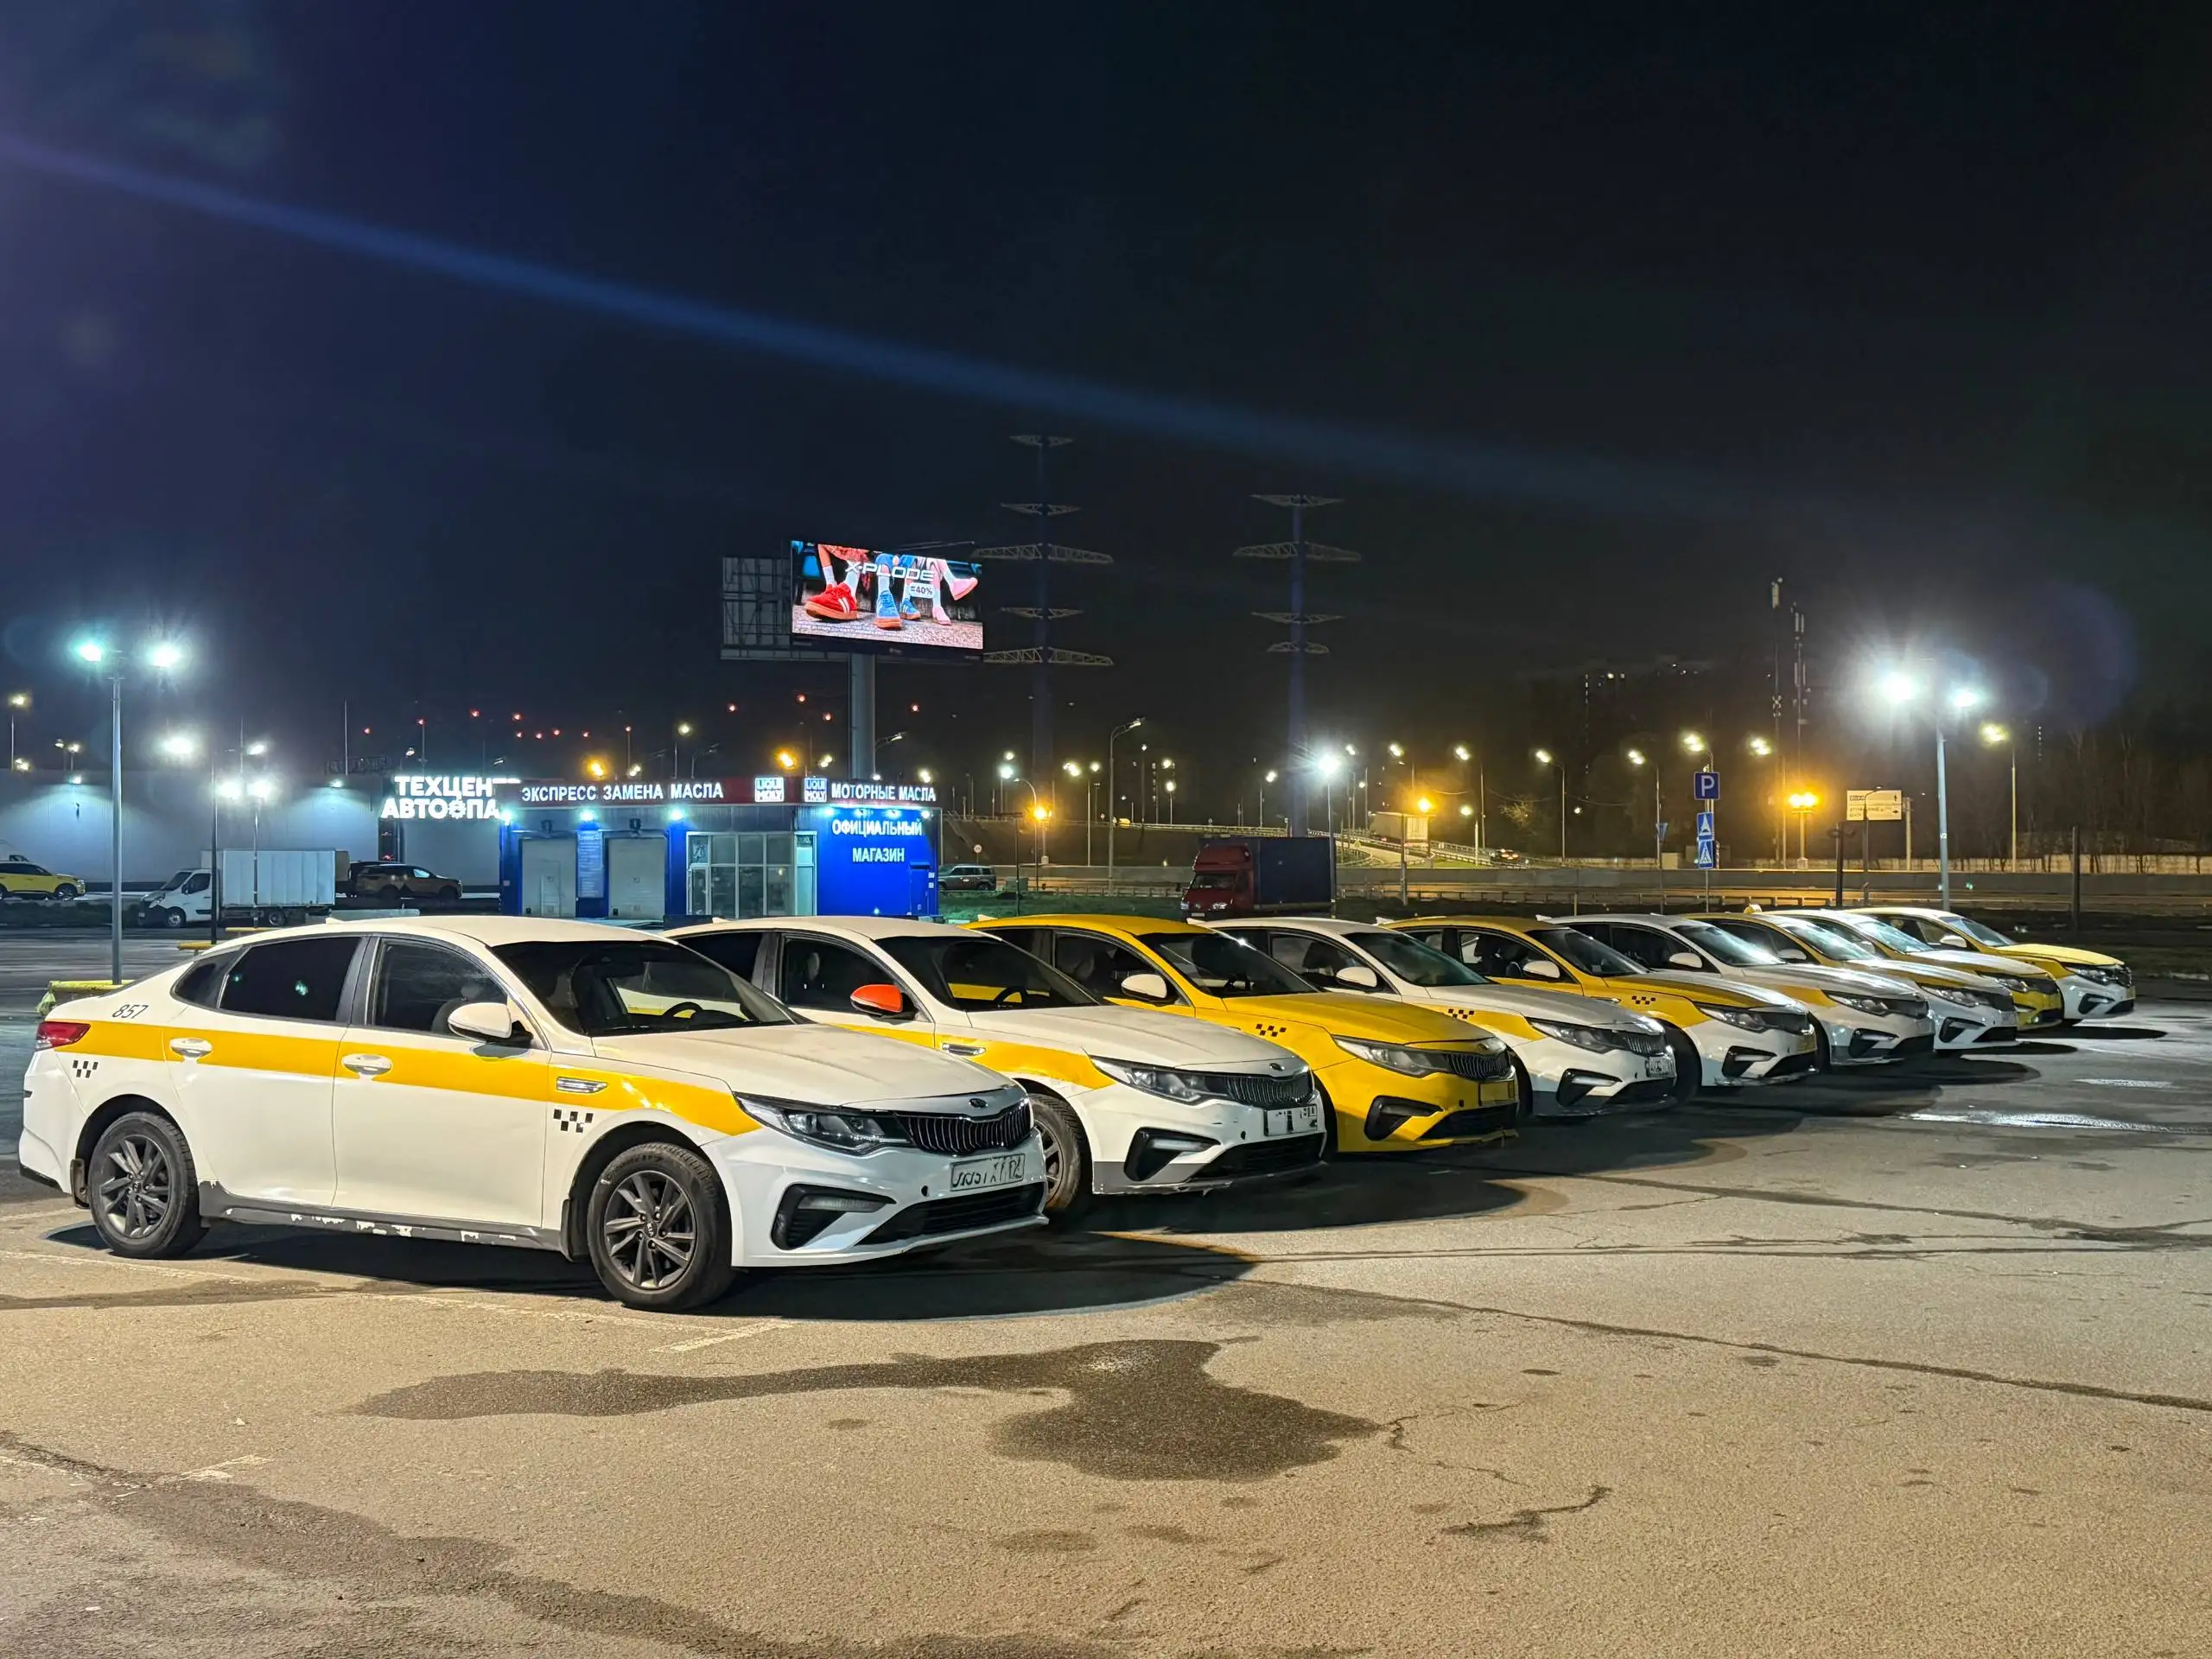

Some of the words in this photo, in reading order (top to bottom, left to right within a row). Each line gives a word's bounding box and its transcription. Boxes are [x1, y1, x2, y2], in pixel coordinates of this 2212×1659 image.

[394, 776, 521, 800] ТЕХЦЕН
[521, 785, 597, 802] ЭКСПРЕСС
[603, 784, 664, 800] ЗАМЕНА
[671, 782, 724, 799] МАСЛА
[805, 779, 826, 790] LIQUI
[831, 783, 896, 800] МОТОРНЫЕ
[899, 785, 936, 801] МАСЛА
[1700, 775, 1715, 797] P
[805, 791, 826, 802] MOLY
[832, 818, 923, 836] ОФИЦИАЛЬНЫЙ
[852, 847, 906, 862] МАГАЗИН
[111, 1004, 149, 1019] 857
